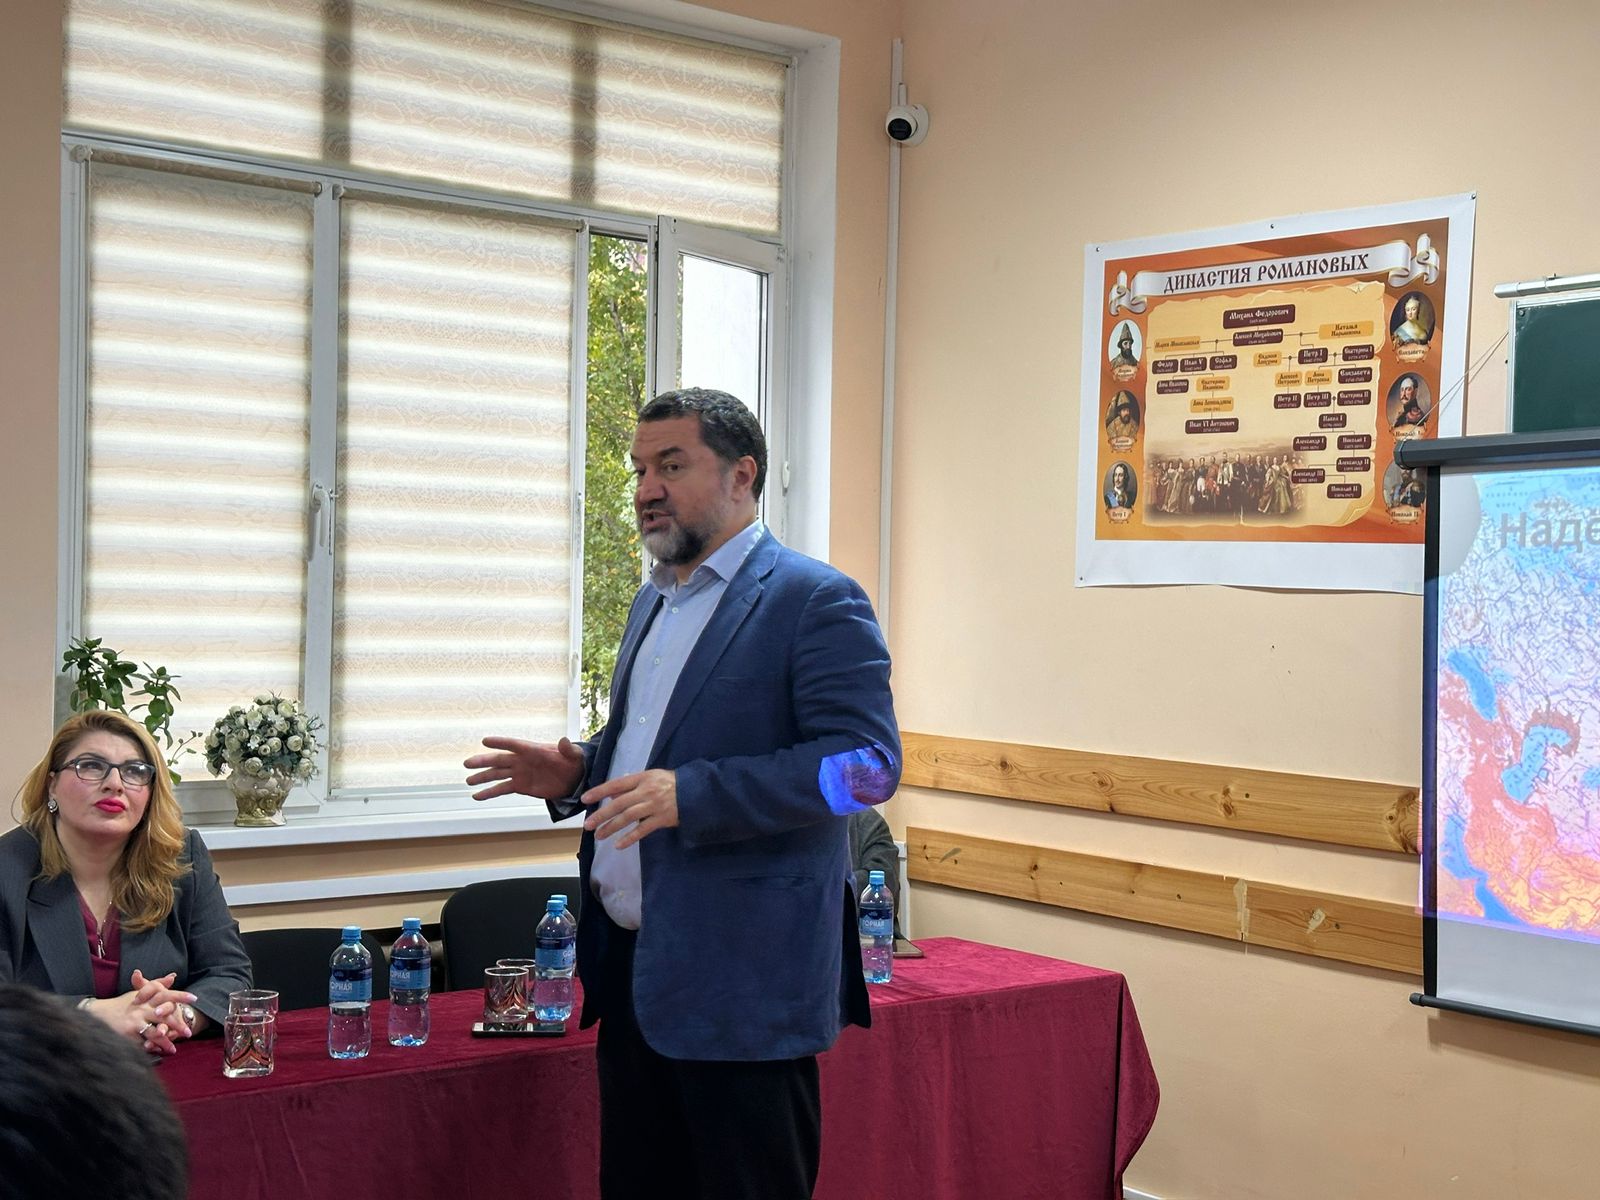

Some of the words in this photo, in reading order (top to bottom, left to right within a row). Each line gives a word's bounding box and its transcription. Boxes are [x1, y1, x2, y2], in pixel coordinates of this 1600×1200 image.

[1164, 267, 1251, 294] ДИНАСТИЯ
[1257, 253, 1369, 281] РОМАНОВЫХ
[390, 971, 411, 980] ОРНАЯ
[330, 981, 353, 991] ОРНАЯ
